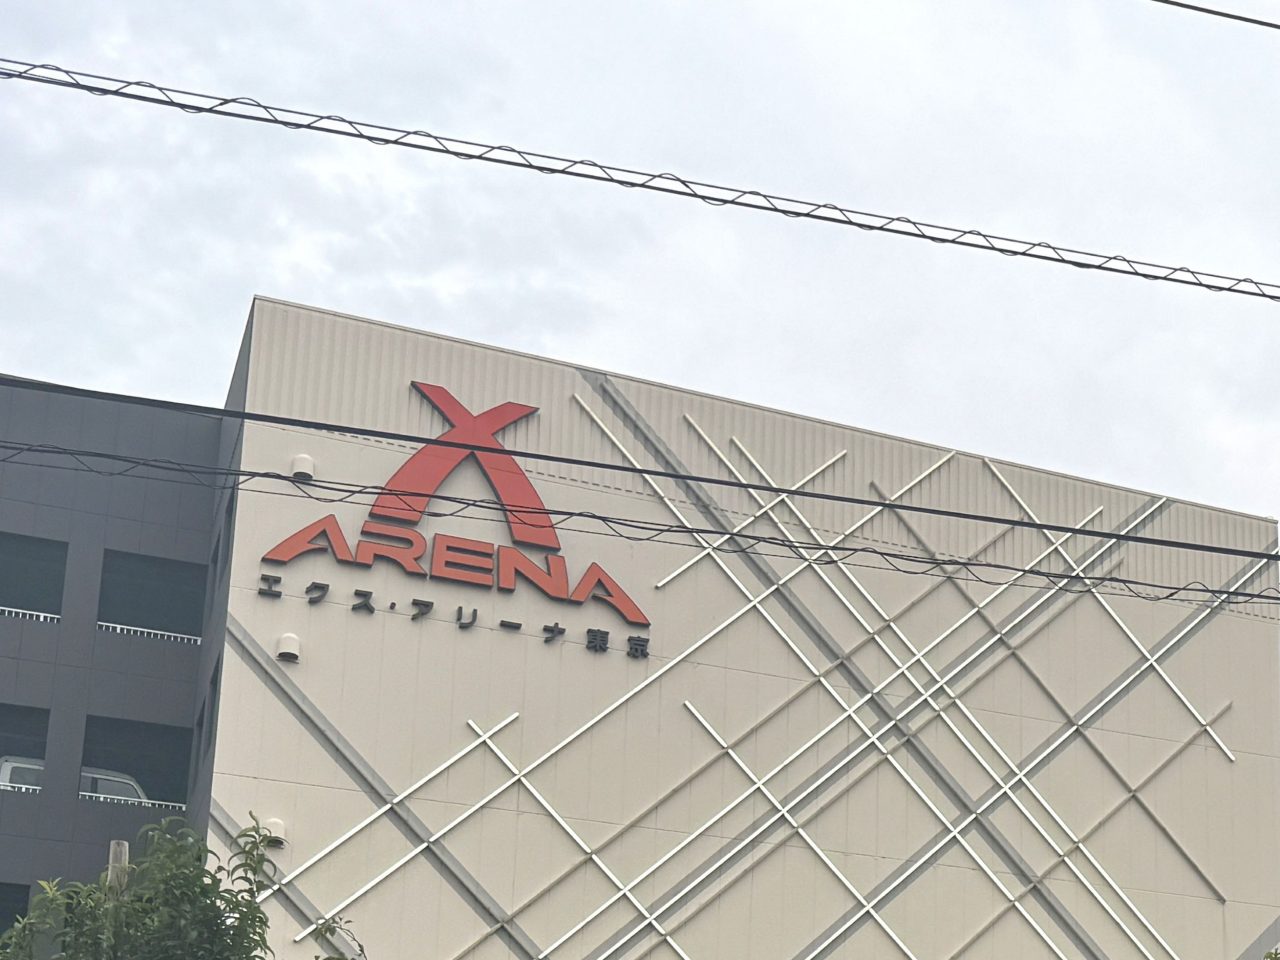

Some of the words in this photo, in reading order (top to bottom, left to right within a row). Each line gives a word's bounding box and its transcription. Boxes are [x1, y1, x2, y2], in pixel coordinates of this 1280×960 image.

[257, 573, 651, 658] エクス・アリーナ東京
[261, 513, 651, 627] ARENA
